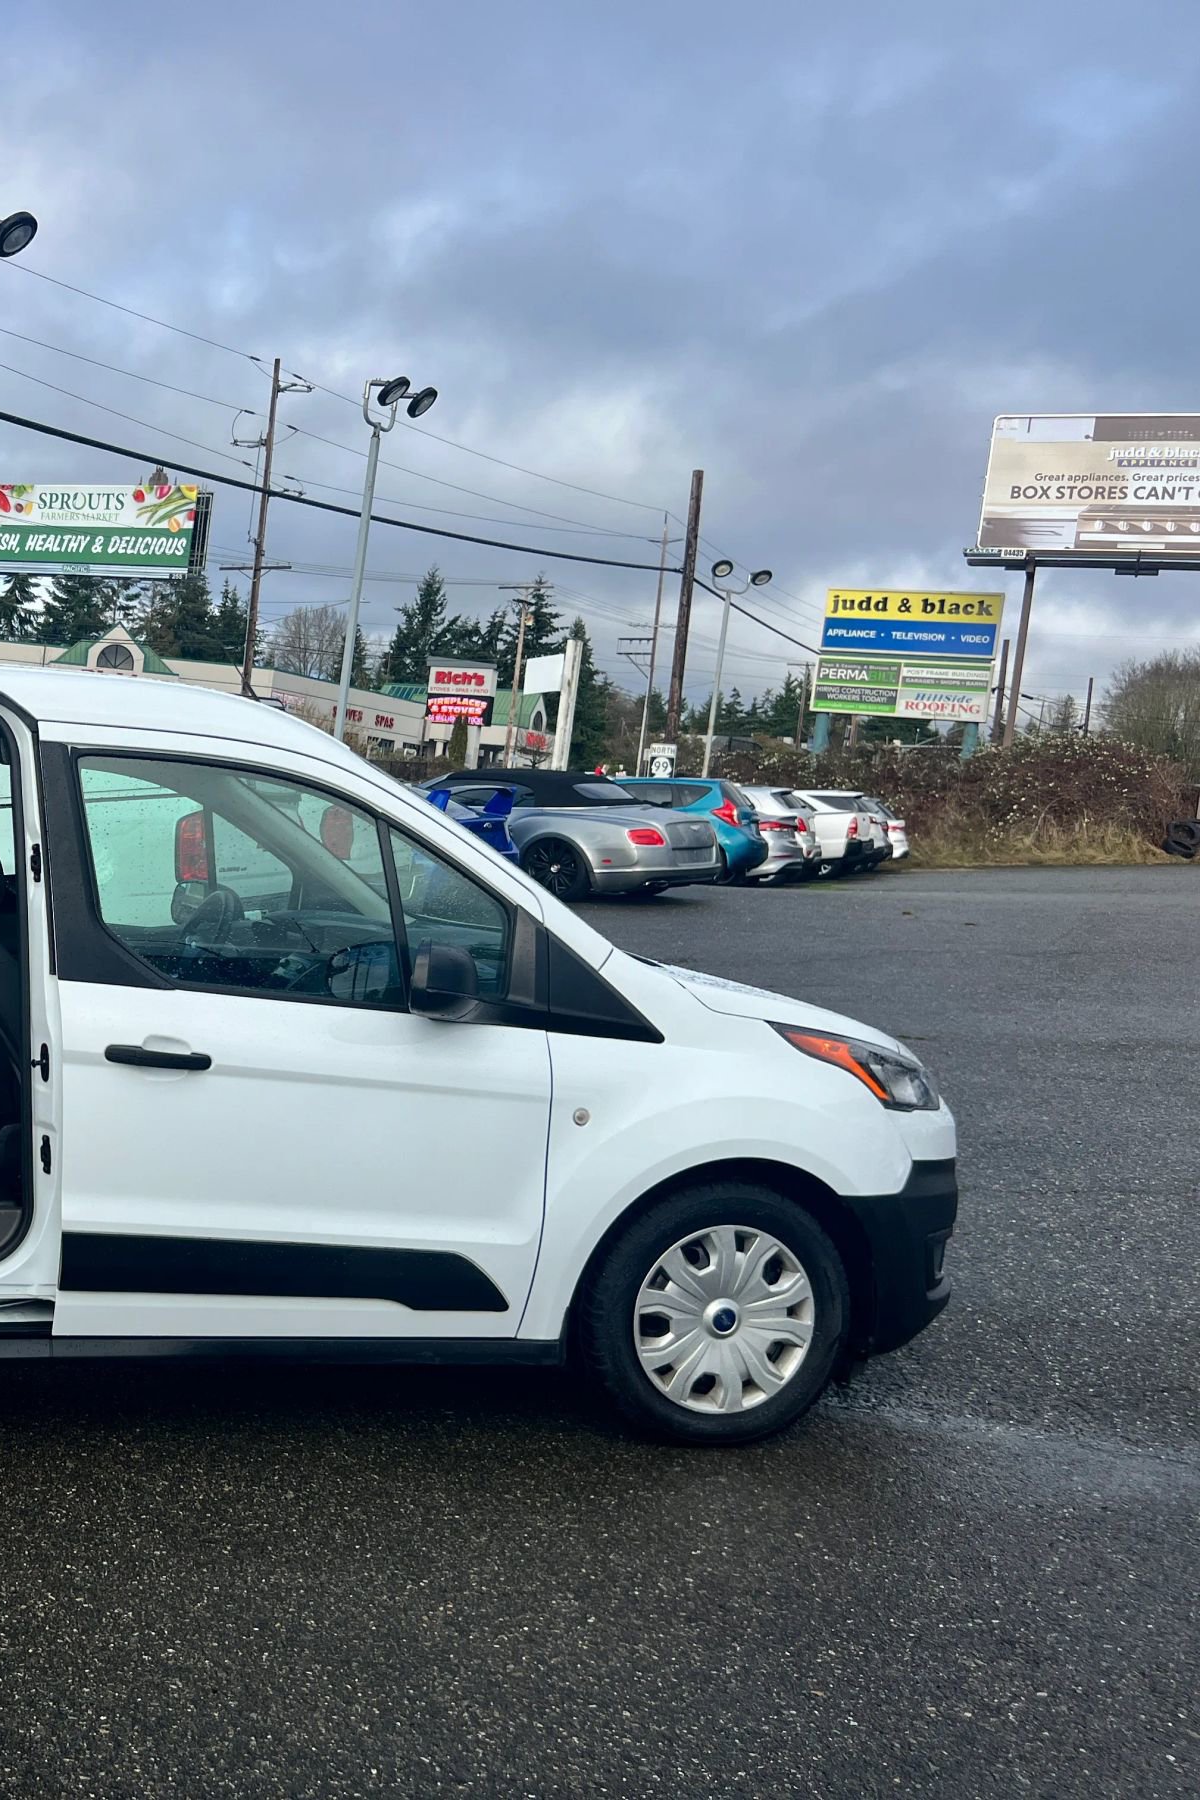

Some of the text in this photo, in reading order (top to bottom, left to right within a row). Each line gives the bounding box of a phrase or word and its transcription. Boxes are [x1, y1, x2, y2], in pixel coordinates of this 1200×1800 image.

[1107, 446, 1200, 461] judd & blac
[1121, 459, 1194, 467] APPLIANCE
[1034, 473, 1065, 482] Great
[1067, 472, 1129, 484] appliances.
[1132, 473, 1164, 482] Great
[1010, 485, 1194, 500] BOX STORES CAN'T
[37, 491, 126, 511] SPROUTS
[40, 511, 120, 522] FARMERS MARKET
[25, 534, 90, 553] HEALTHY
[91, 538, 103, 553] &
[107, 536, 187, 556] DELICIOUS
[831, 594, 993, 617] judd & black
[826, 628, 990, 644] APPLIANCE TELEVISION VIDEO
[434, 671, 485, 687] Rich's
[826, 693, 860, 702] WORKERS
[841, 687, 897, 698] CONSTRUCTION
[427, 696, 488, 709] FIREPLACES
[904, 700, 981, 715] ROOFING
[441, 705, 482, 715] STOVES
[374, 714, 395, 729] SPAS
[652, 746, 676, 754] NORTH
[654, 761, 669, 772] 99
